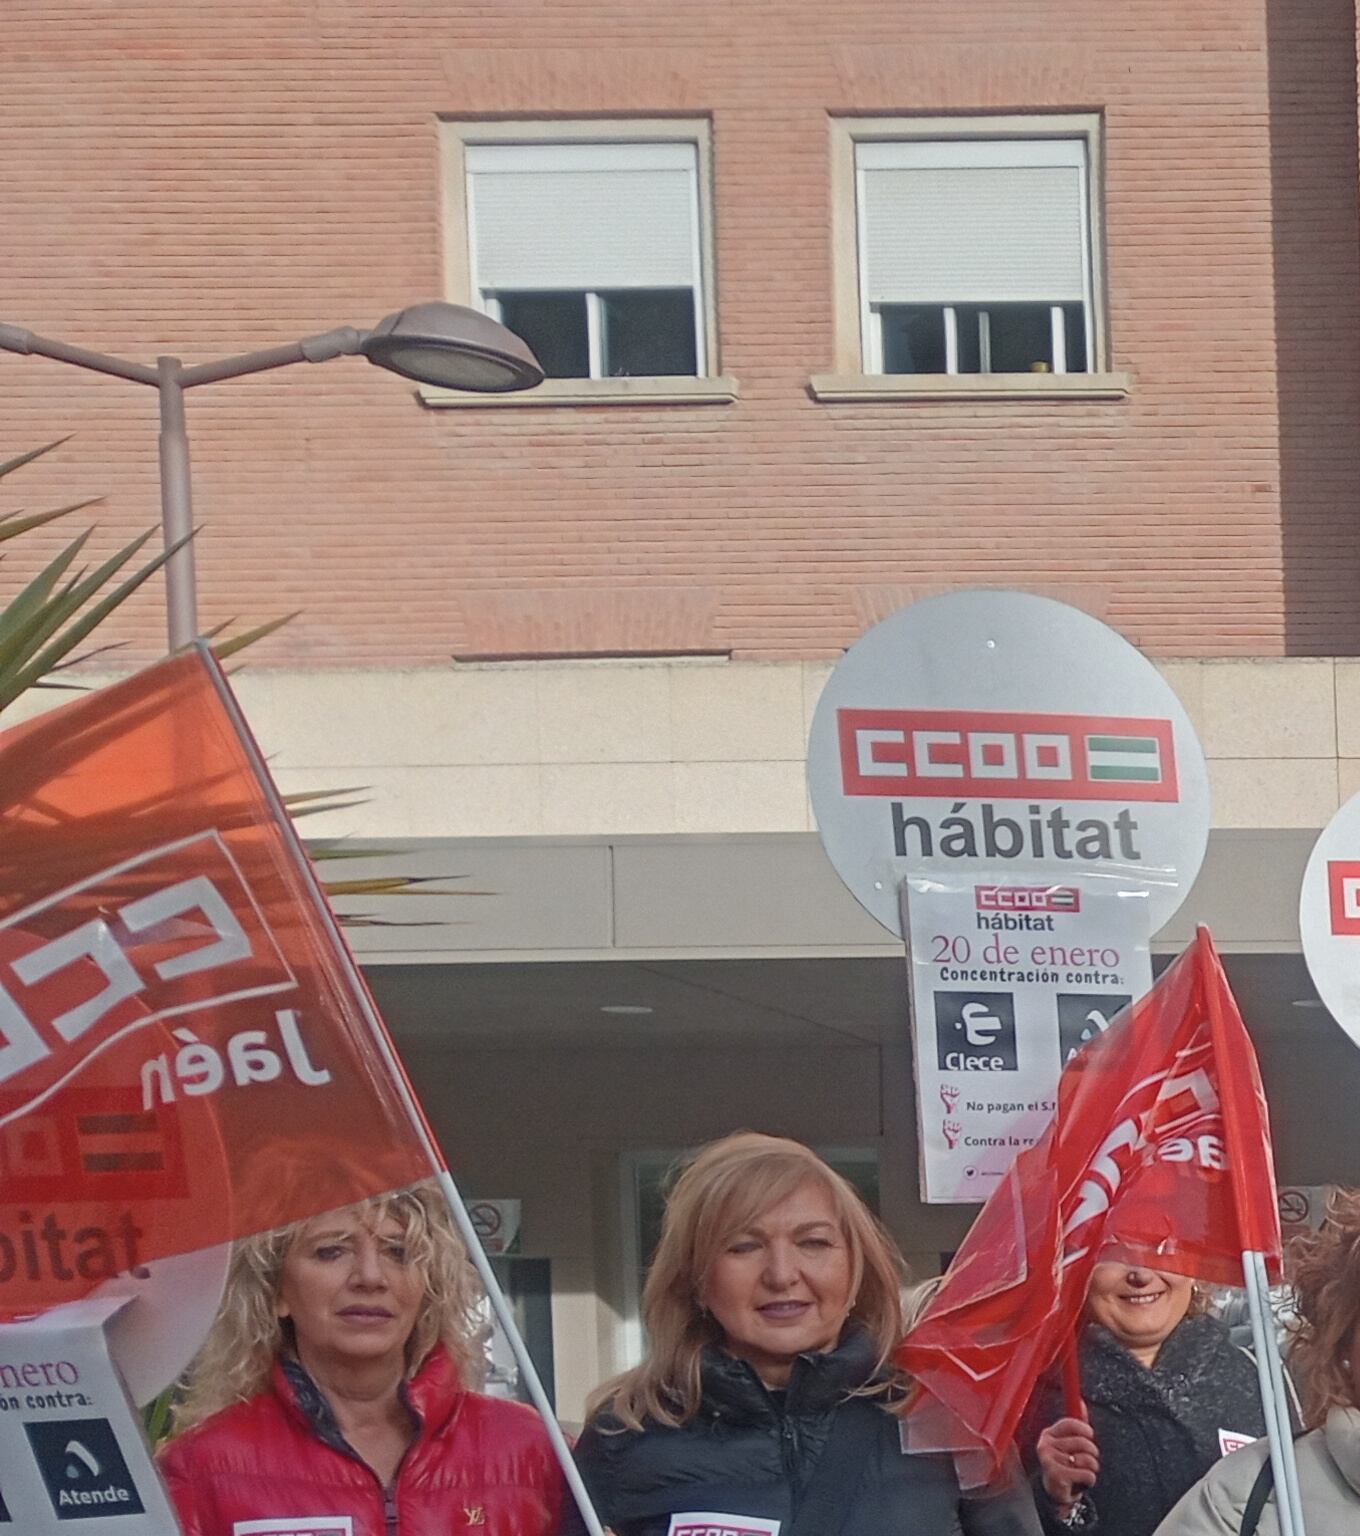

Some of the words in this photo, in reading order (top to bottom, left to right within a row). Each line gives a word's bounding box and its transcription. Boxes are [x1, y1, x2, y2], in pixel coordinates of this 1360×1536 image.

[855, 729, 1073, 781] CCOO
[891, 801, 1142, 860] hábitat
[980, 889, 1047, 907] CCOO
[976, 912, 1054, 931] hábitat
[931, 934, 971, 964] 20
[983, 932, 1020, 965] de
[1030, 944, 1120, 968] enero
[940, 967, 1059, 984] Concentración
[1066, 971, 1124, 986] contra:
[945, 1052, 1004, 1071] Clece
[966, 1102, 984, 1111] No
[987, 1103, 1024, 1113] pagan
[1028, 1102, 1038, 1111] el
[964, 1136, 1005, 1146] Contra
[1009, 1136, 1020, 1146] la
[26, 1391, 94, 1409] contra:
[58, 1485, 129, 1506] Atende
